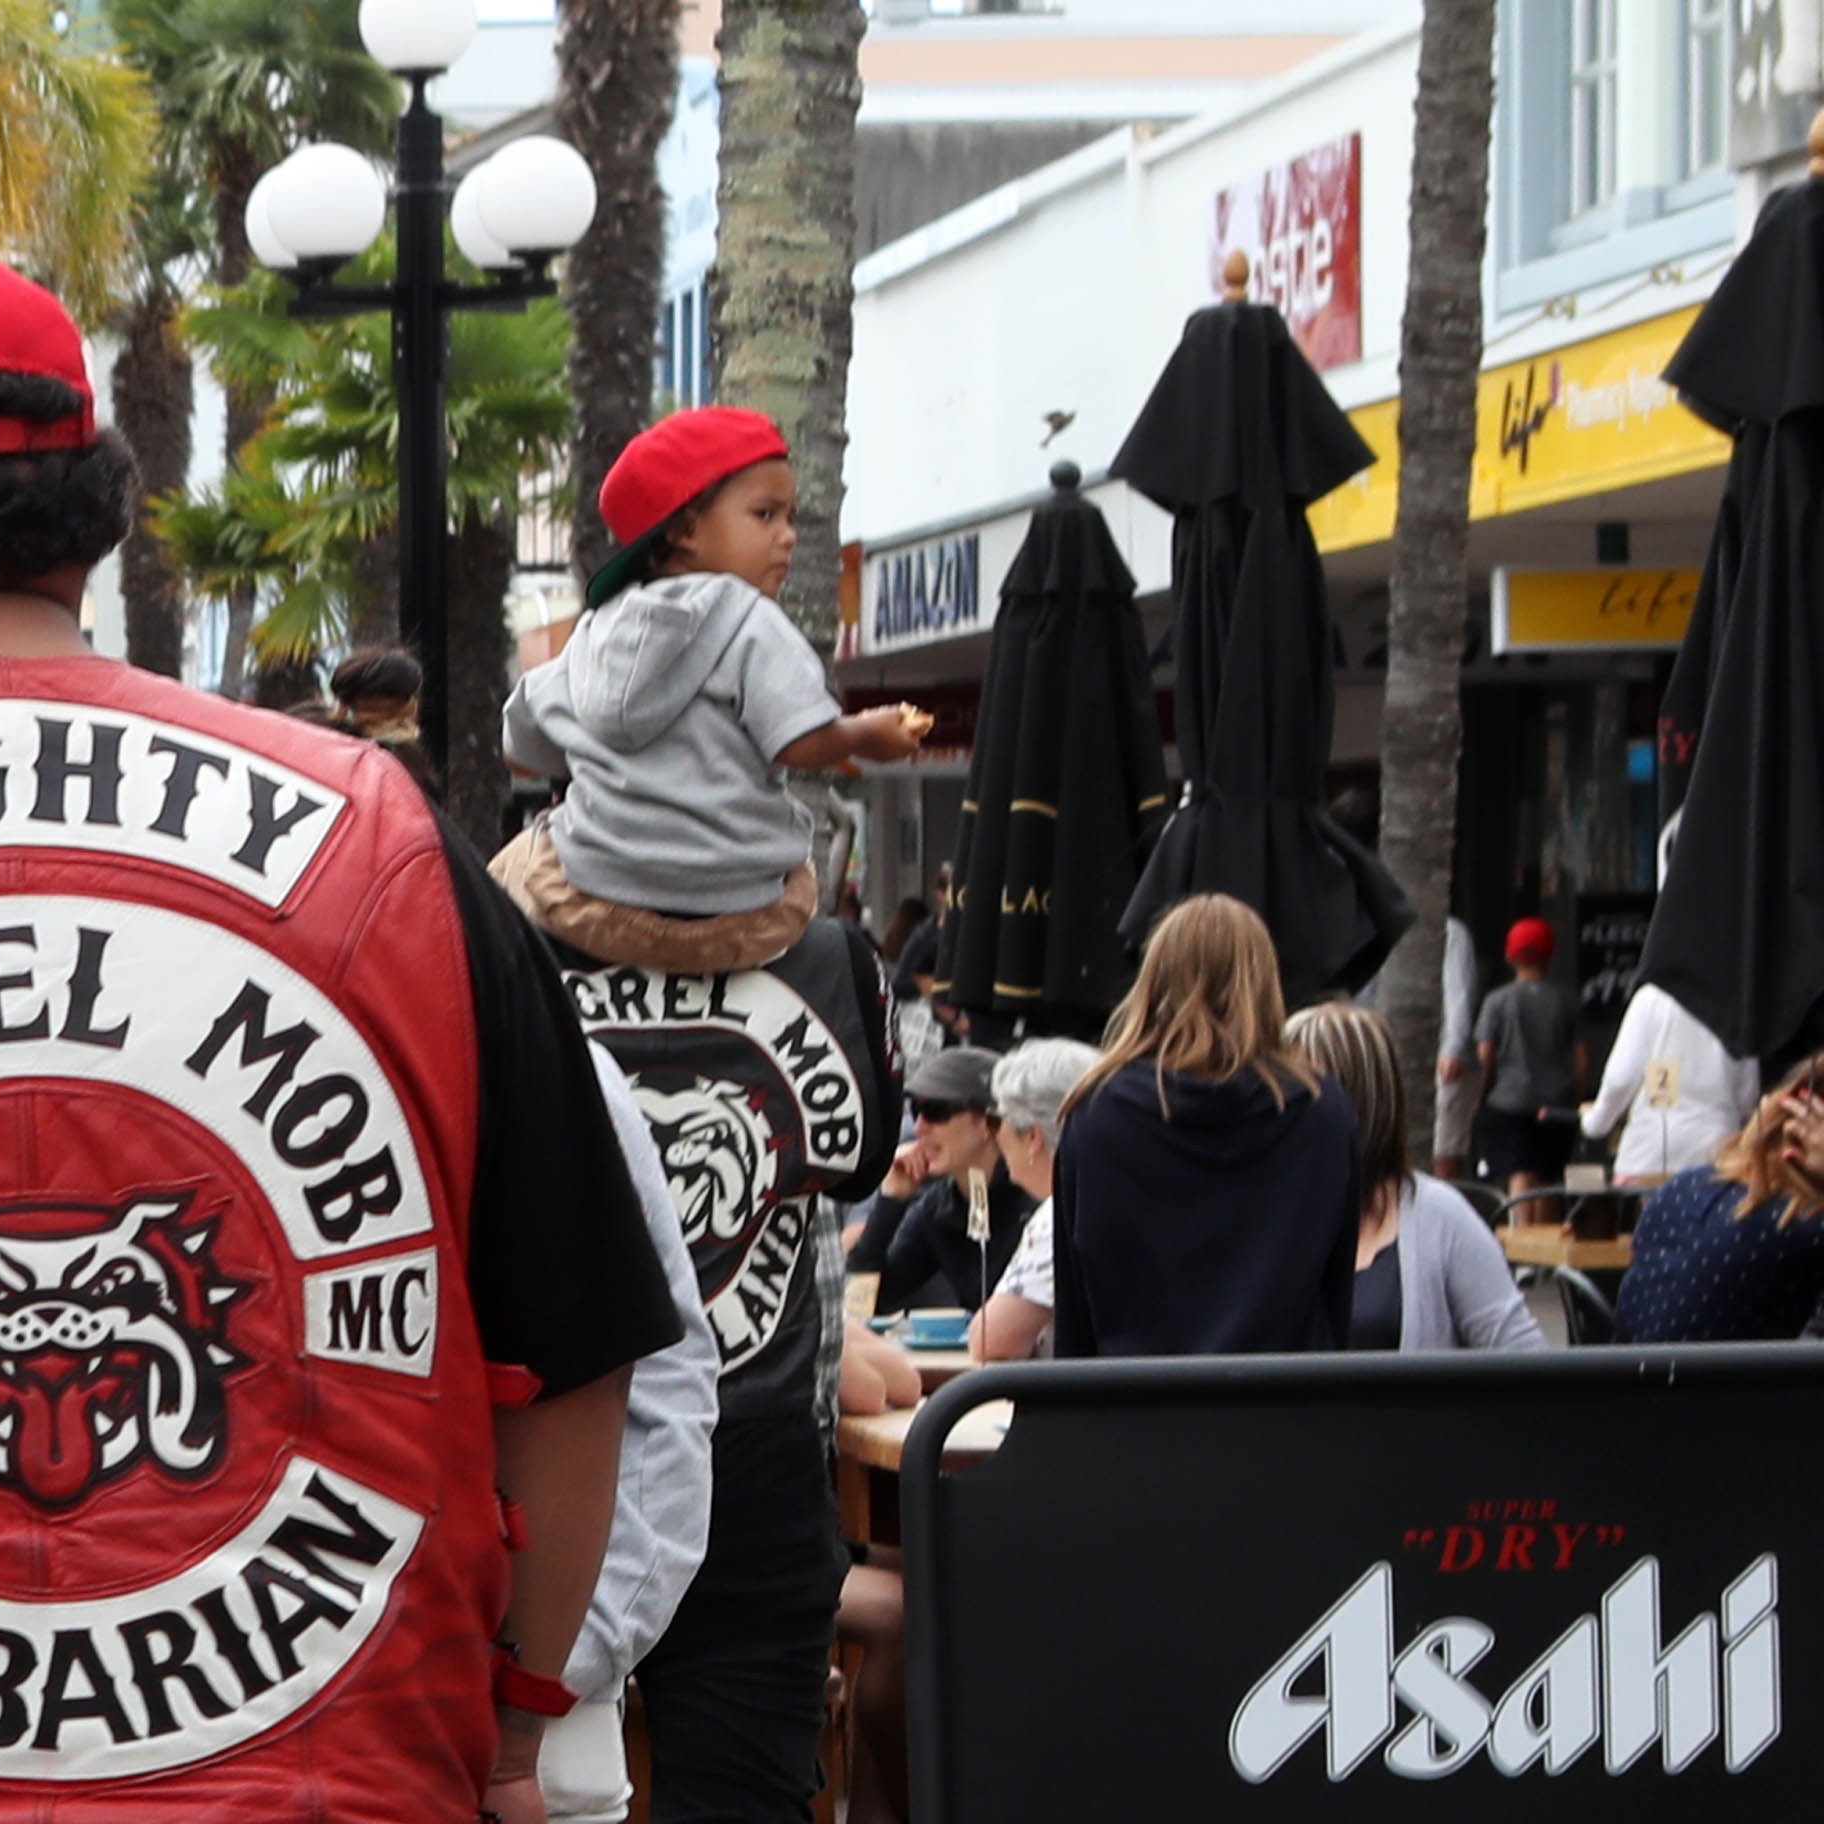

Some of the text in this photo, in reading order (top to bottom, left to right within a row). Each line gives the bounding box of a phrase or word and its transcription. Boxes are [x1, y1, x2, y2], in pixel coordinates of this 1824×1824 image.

[875, 533, 980, 645] AMAZON
[186, 976, 406, 1245] MOB
[563, 966, 752, 1026] GREL
[774, 1012, 860, 1166] MOB
[326, 1265, 432, 1358] MC
[1466, 1498, 1559, 1521] SUPER
[1228, 1552, 1782, 1784] Asahi
